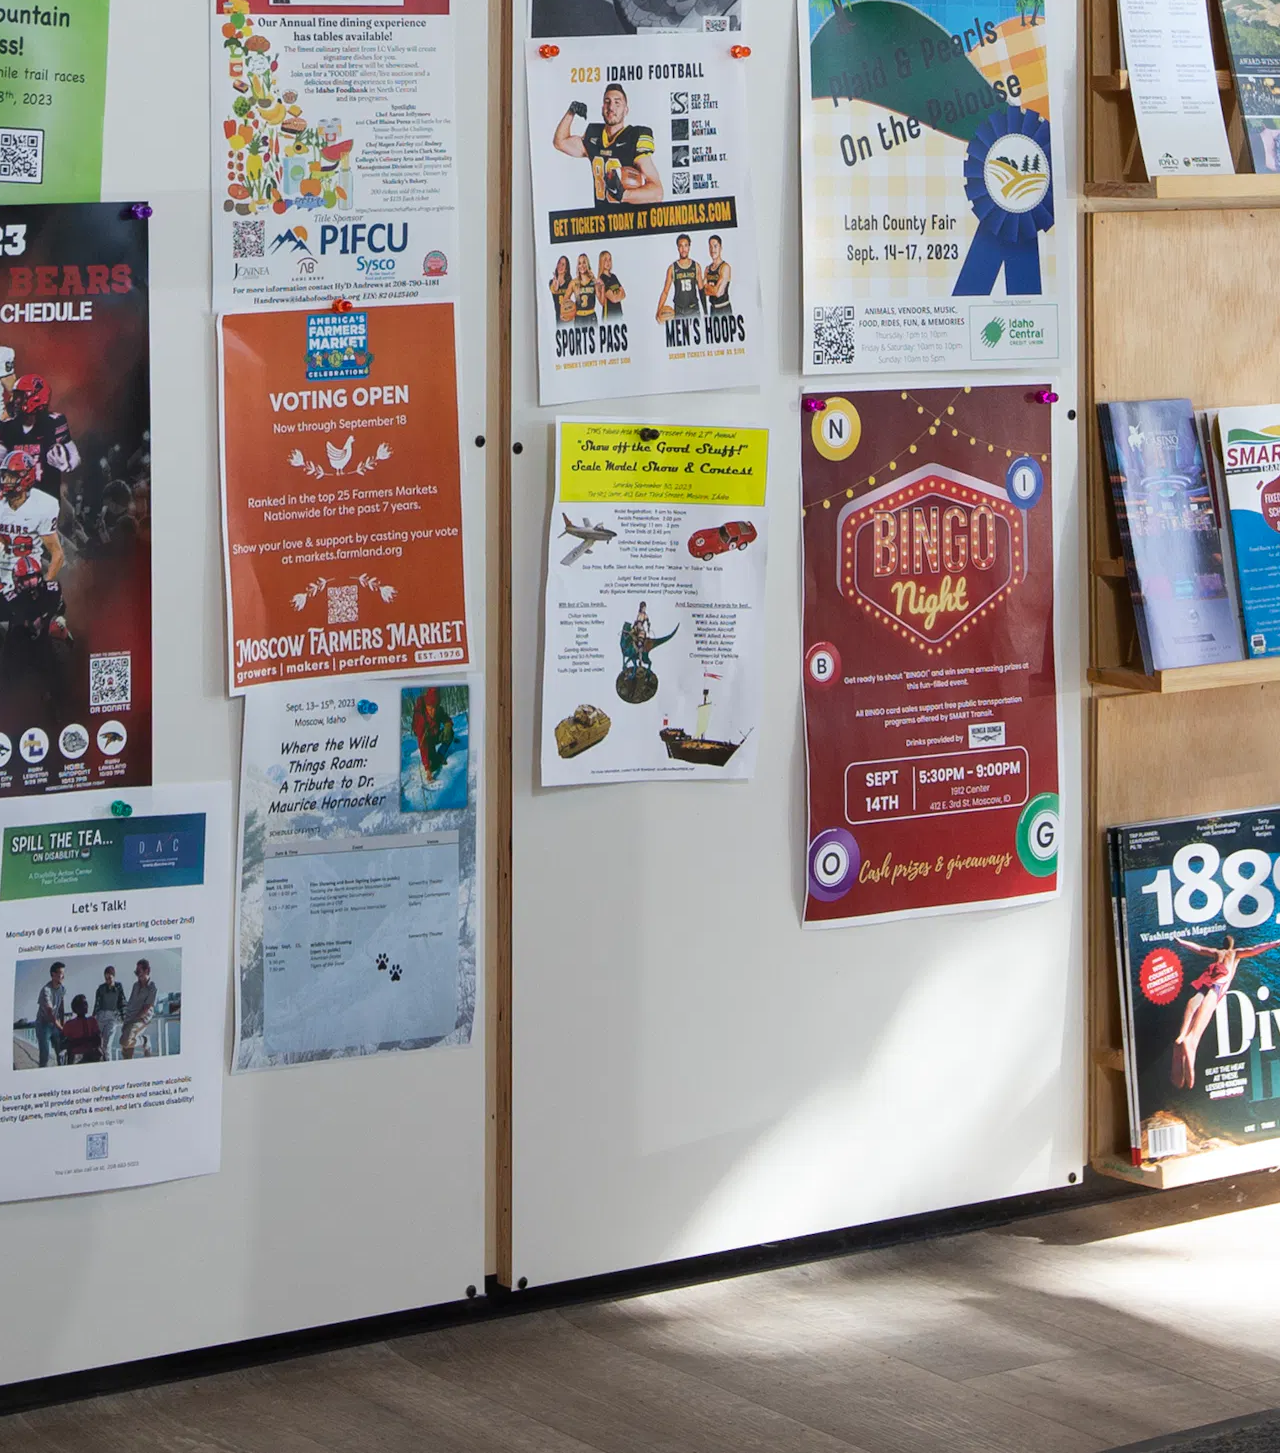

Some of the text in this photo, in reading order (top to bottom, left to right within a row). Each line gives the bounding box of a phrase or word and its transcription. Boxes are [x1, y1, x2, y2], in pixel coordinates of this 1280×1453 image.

[24, 68, 48, 81] trail
[54, 72, 85, 83] races
[571, 62, 704, 83] 2023 IDAHO FOOTBALL
[844, 215, 957, 234] Latah County Fair
[320, 223, 408, 256] P1FCU
[847, 244, 959, 263] Sept. 14-17, 2023
[8, 263, 133, 298] BEARS
[555, 324, 628, 358] SPORTS PASS
[270, 385, 409, 412] VOTING OPEN
[273, 415, 407, 433] Now through September 18
[571, 461, 753, 476] Scale Model Show & Contest
[874, 504, 998, 579] BINGO
[891, 576, 970, 630] Night
[865, 768, 899, 787] SEPT
[268, 793, 386, 814] Maurice Hornocker
[865, 795, 900, 813] 14TH
[11, 829, 114, 853] SPILL THE TEA...
[71, 900, 127, 914] Let's Talk!
